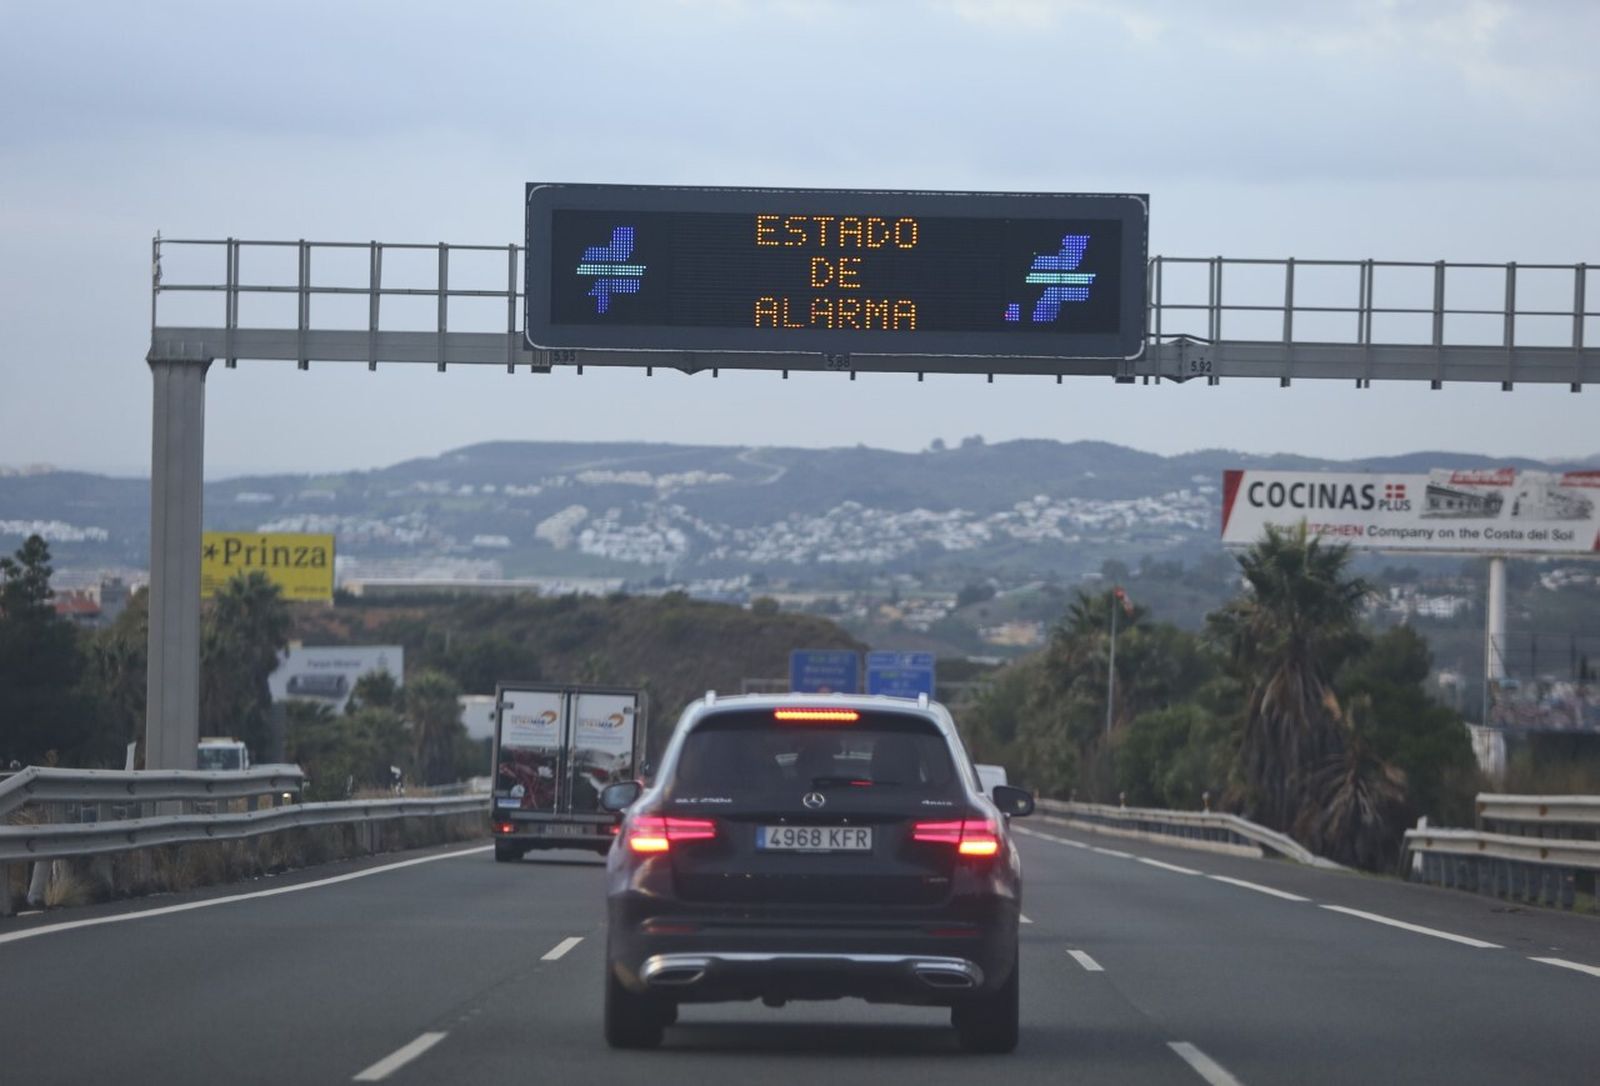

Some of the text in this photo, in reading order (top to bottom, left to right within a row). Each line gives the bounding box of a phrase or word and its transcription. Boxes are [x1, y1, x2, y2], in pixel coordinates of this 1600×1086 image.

[756, 214, 917, 249] ESTADO
[810, 256, 861, 288] DE
[754, 296, 916, 330] ALARMA
[1247, 481, 1411, 512] COCINAS PLUS
[1367, 525, 1433, 540] Company
[1438, 528, 1455, 538] on
[1459, 527, 1480, 539] the
[1484, 527, 1523, 540] Costa
[1527, 528, 1547, 541] del
[1552, 529, 1574, 542] Sol
[223, 537, 327, 568] Prinza
[769, 828, 868, 848] 4968 KFR
